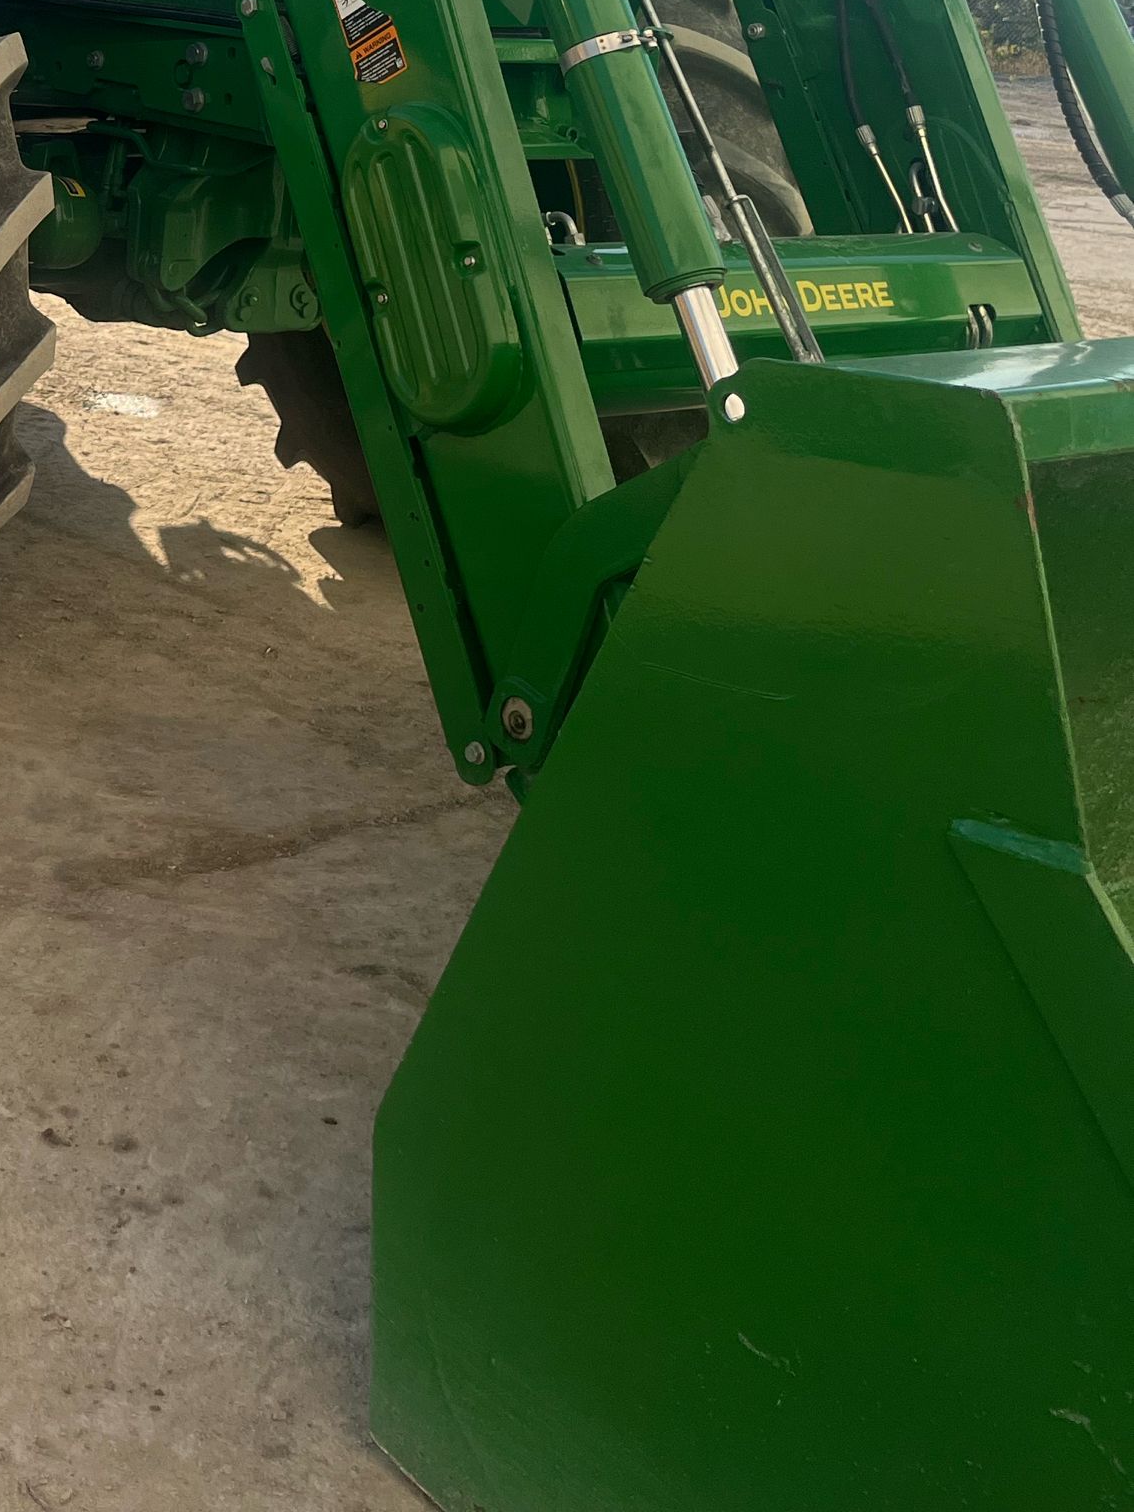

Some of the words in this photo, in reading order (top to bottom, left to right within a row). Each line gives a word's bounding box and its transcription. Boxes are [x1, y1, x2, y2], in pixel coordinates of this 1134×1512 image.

[362, 31, 392, 53] WARNING
[718, 285, 788, 318] JOH
[796, 280, 894, 312] DEERE
